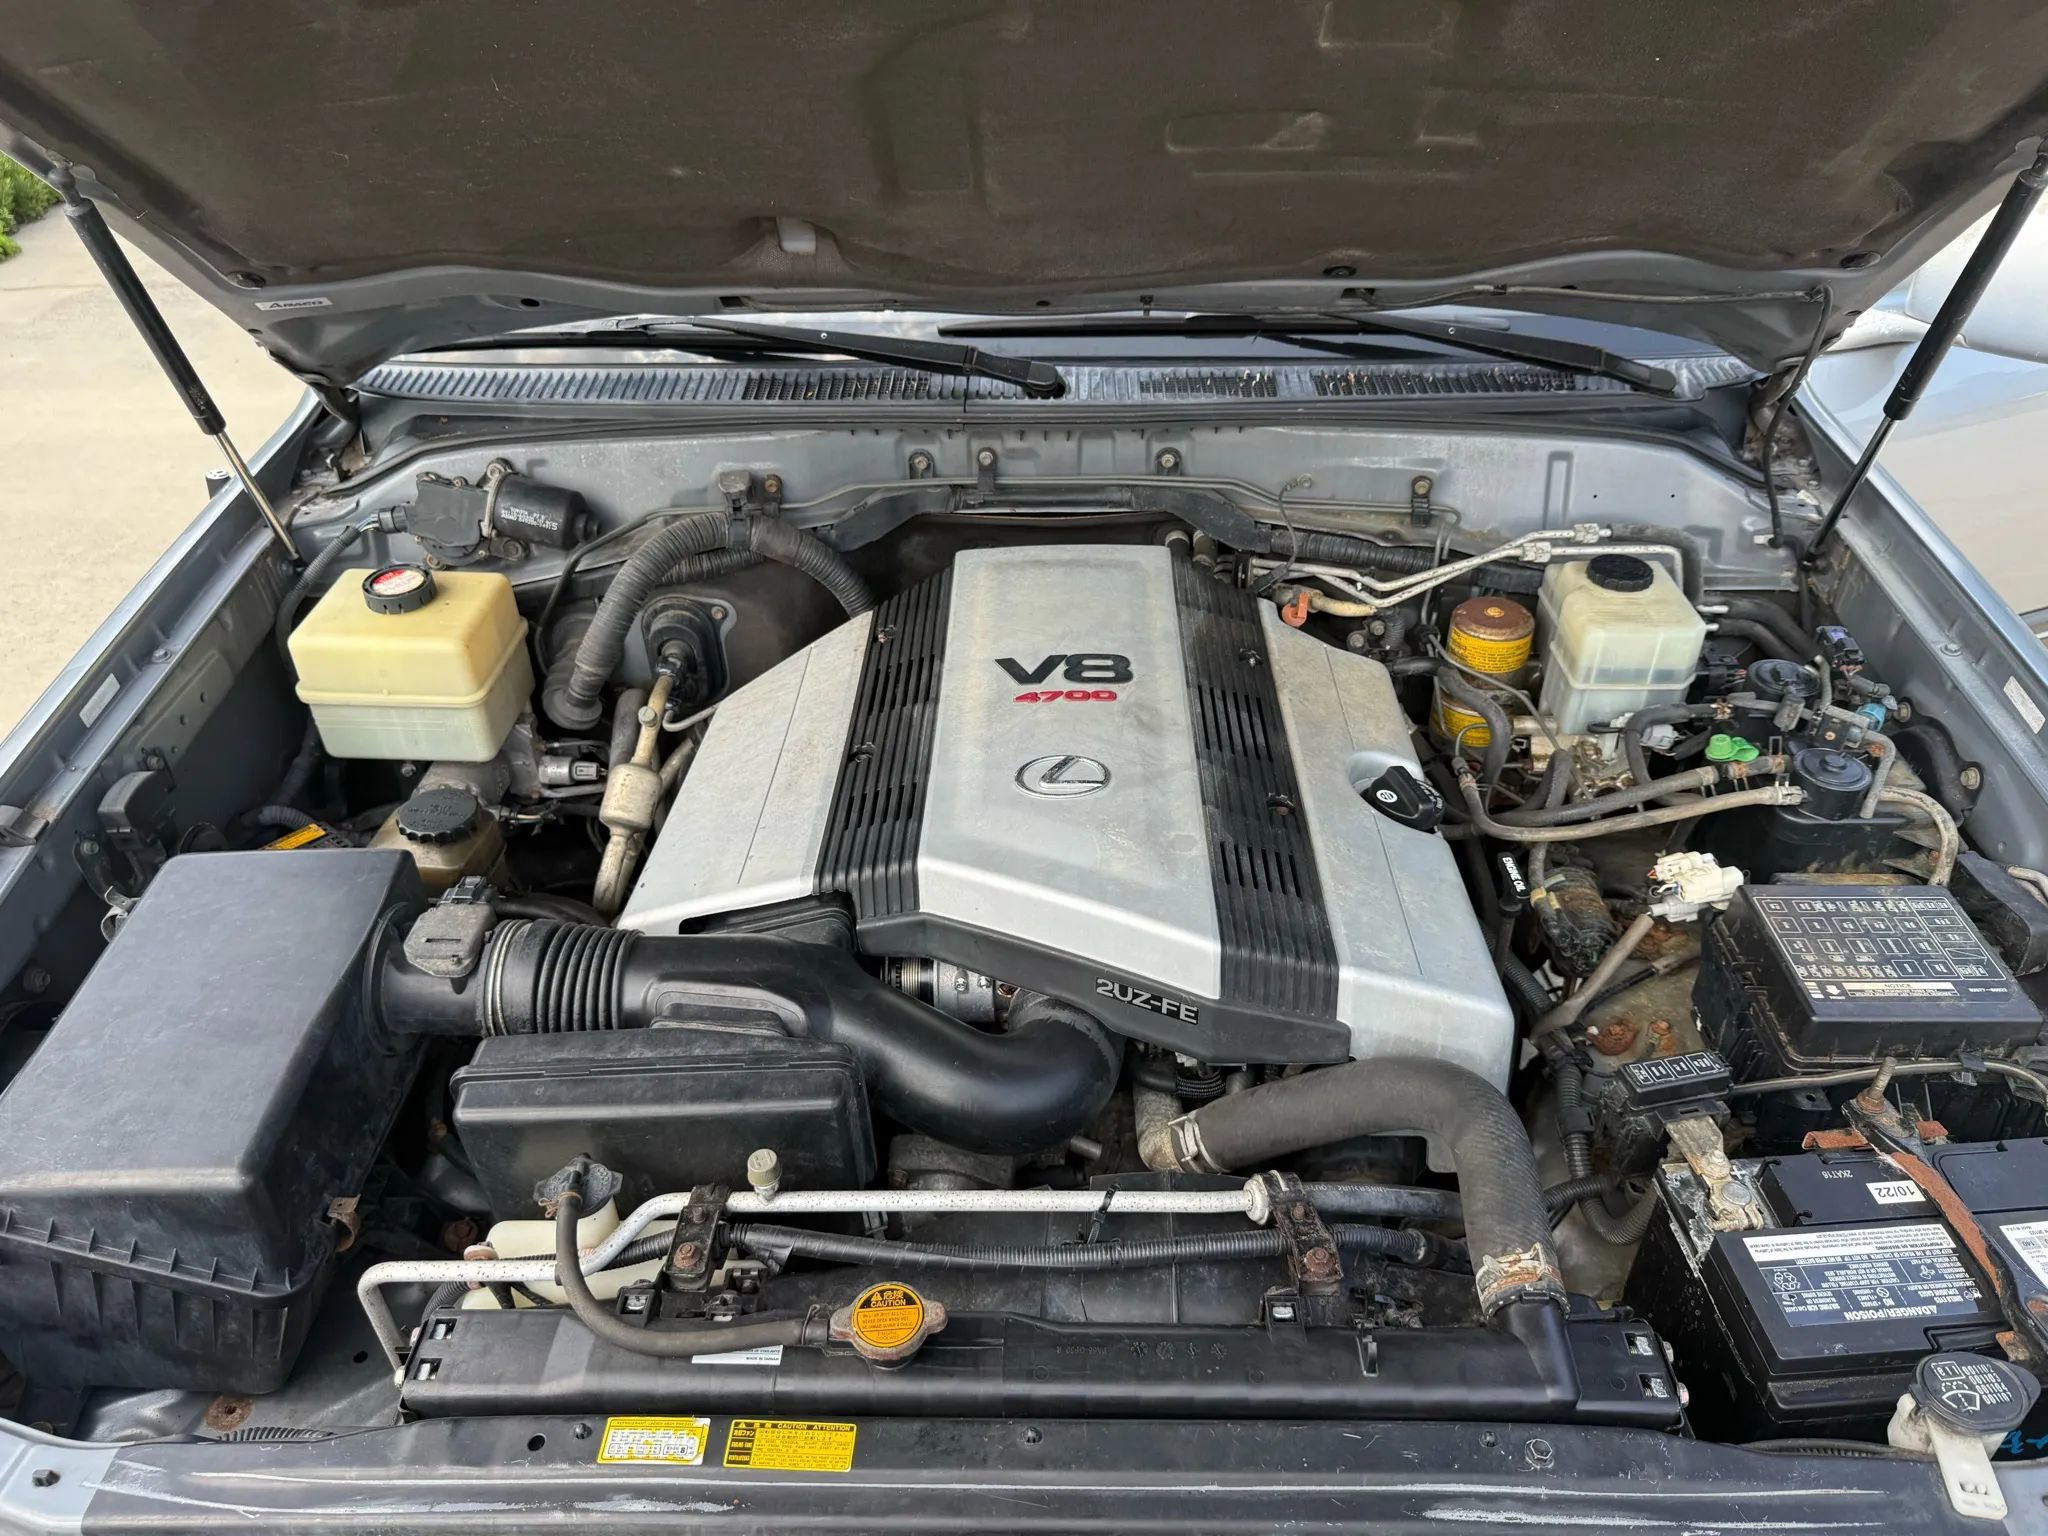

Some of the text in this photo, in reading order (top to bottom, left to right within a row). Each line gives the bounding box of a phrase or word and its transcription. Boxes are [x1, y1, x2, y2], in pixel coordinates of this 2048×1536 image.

[994, 653, 1134, 685] V8
[1013, 690, 1118, 703] 4700
[1502, 856, 1527, 893] ENGINE OIL
[1096, 978, 1197, 1024] 2UZ-FE
[1874, 1185, 1915, 1199] 10/22
[870, 1299, 906, 1308] CAUTION
[1843, 1306, 1931, 1320] DANGER/POISON
[1969, 1373, 2001, 1385] 001103
[1976, 1383, 2008, 1395] 001104
[812, 1424, 852, 1432] ATTENTION
